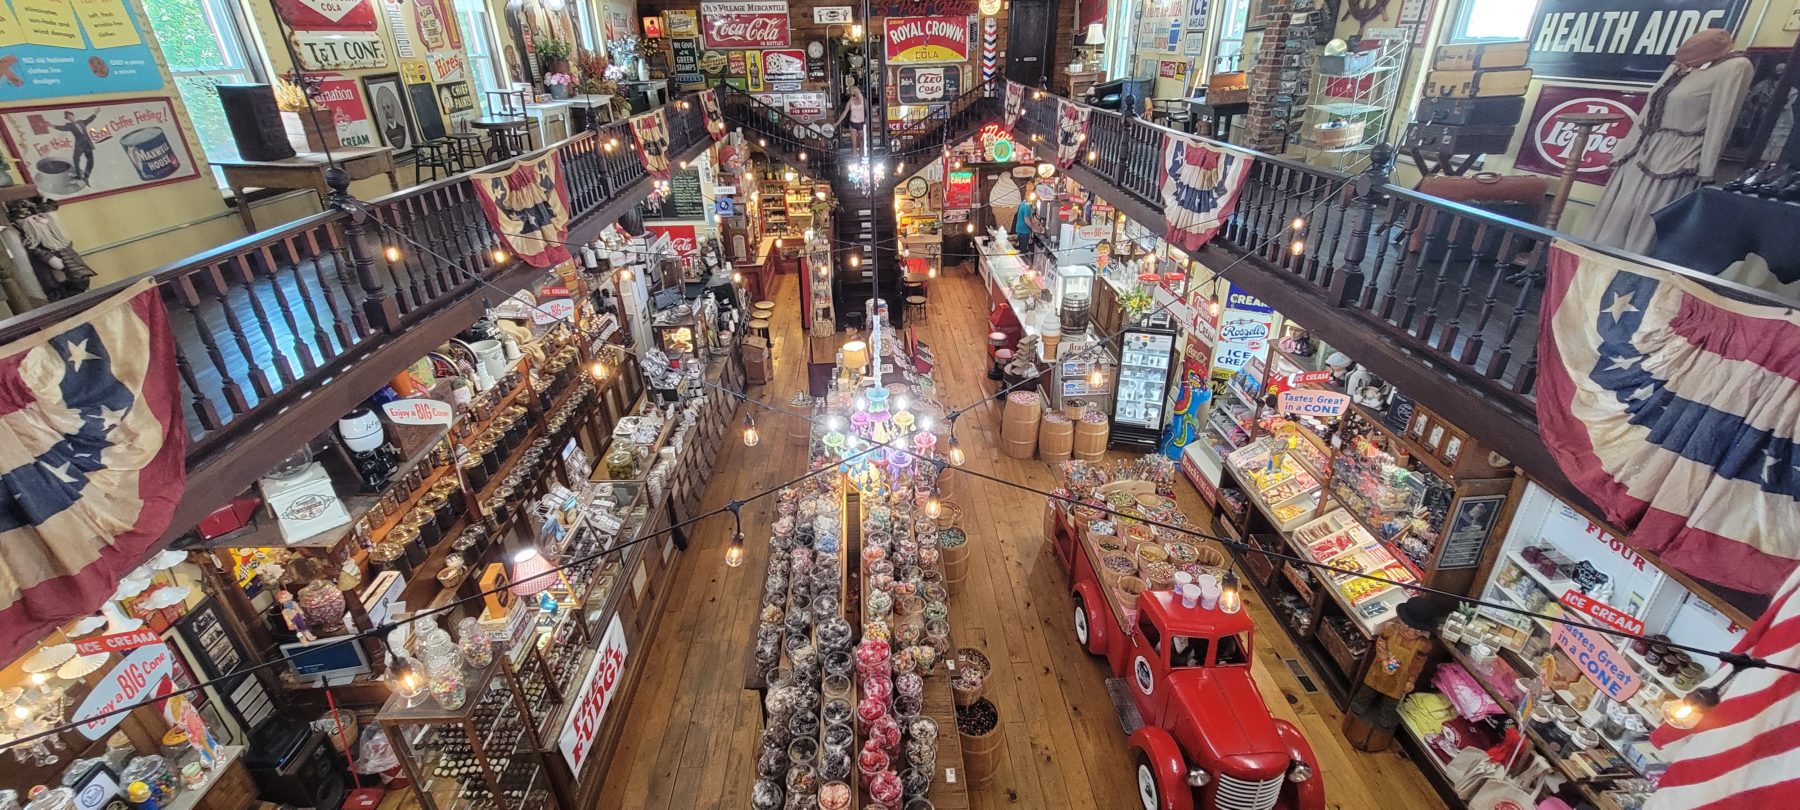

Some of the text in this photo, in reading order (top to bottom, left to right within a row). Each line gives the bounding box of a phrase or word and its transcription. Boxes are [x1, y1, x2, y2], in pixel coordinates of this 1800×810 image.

[320, 2, 342, 12] COLA
[747, 4, 785, 12] MERCANTILE
[1190, 0, 1208, 16] ICE
[711, 17, 784, 42] Coca-Cola
[1189, 18, 1204, 27] AHEAD
[889, 20, 924, 45] ROYAL
[925, 20, 965, 43] CROWN
[1534, 10, 1639, 55] HEALTH
[304, 42, 339, 64] T&T
[681, 41, 693, 49] GIVE
[915, 51, 939, 59] COLA
[435, 55, 460, 78] Hires
[451, 83, 469, 96] CHIEF
[89, 106, 169, 143] Good Coffee Feeling!
[51, 136, 73, 149] that
[341, 134, 370, 148] CREAM
[137, 144, 170, 161] MAXWELL
[149, 155, 173, 171] HOUSE
[1217, 356, 1246, 367] CRE
[1228, 349, 1252, 359] ICE
[1306, 373, 1329, 381] CREAM
[1284, 392, 1345, 405] Tastes Great
[389, 408, 410, 419] Enjoy
[414, 403, 433, 420] BIG
[432, 407, 449, 417] Cone
[1285, 402, 1294, 411] in
[1304, 404, 1340, 414] CONE
[1585, 520, 1647, 573] FLOUR
[1565, 592, 1643, 635] ICE CREAM
[77, 631, 157, 654] ICE CREAM
[1561, 613, 1633, 686] Tastes Great
[1557, 630, 1623, 697] in a CONE
[83, 652, 166, 731] Ejoy a BIG Cone
[572, 639, 614, 740] FRESH
[571, 642, 624, 770] FUDGE
